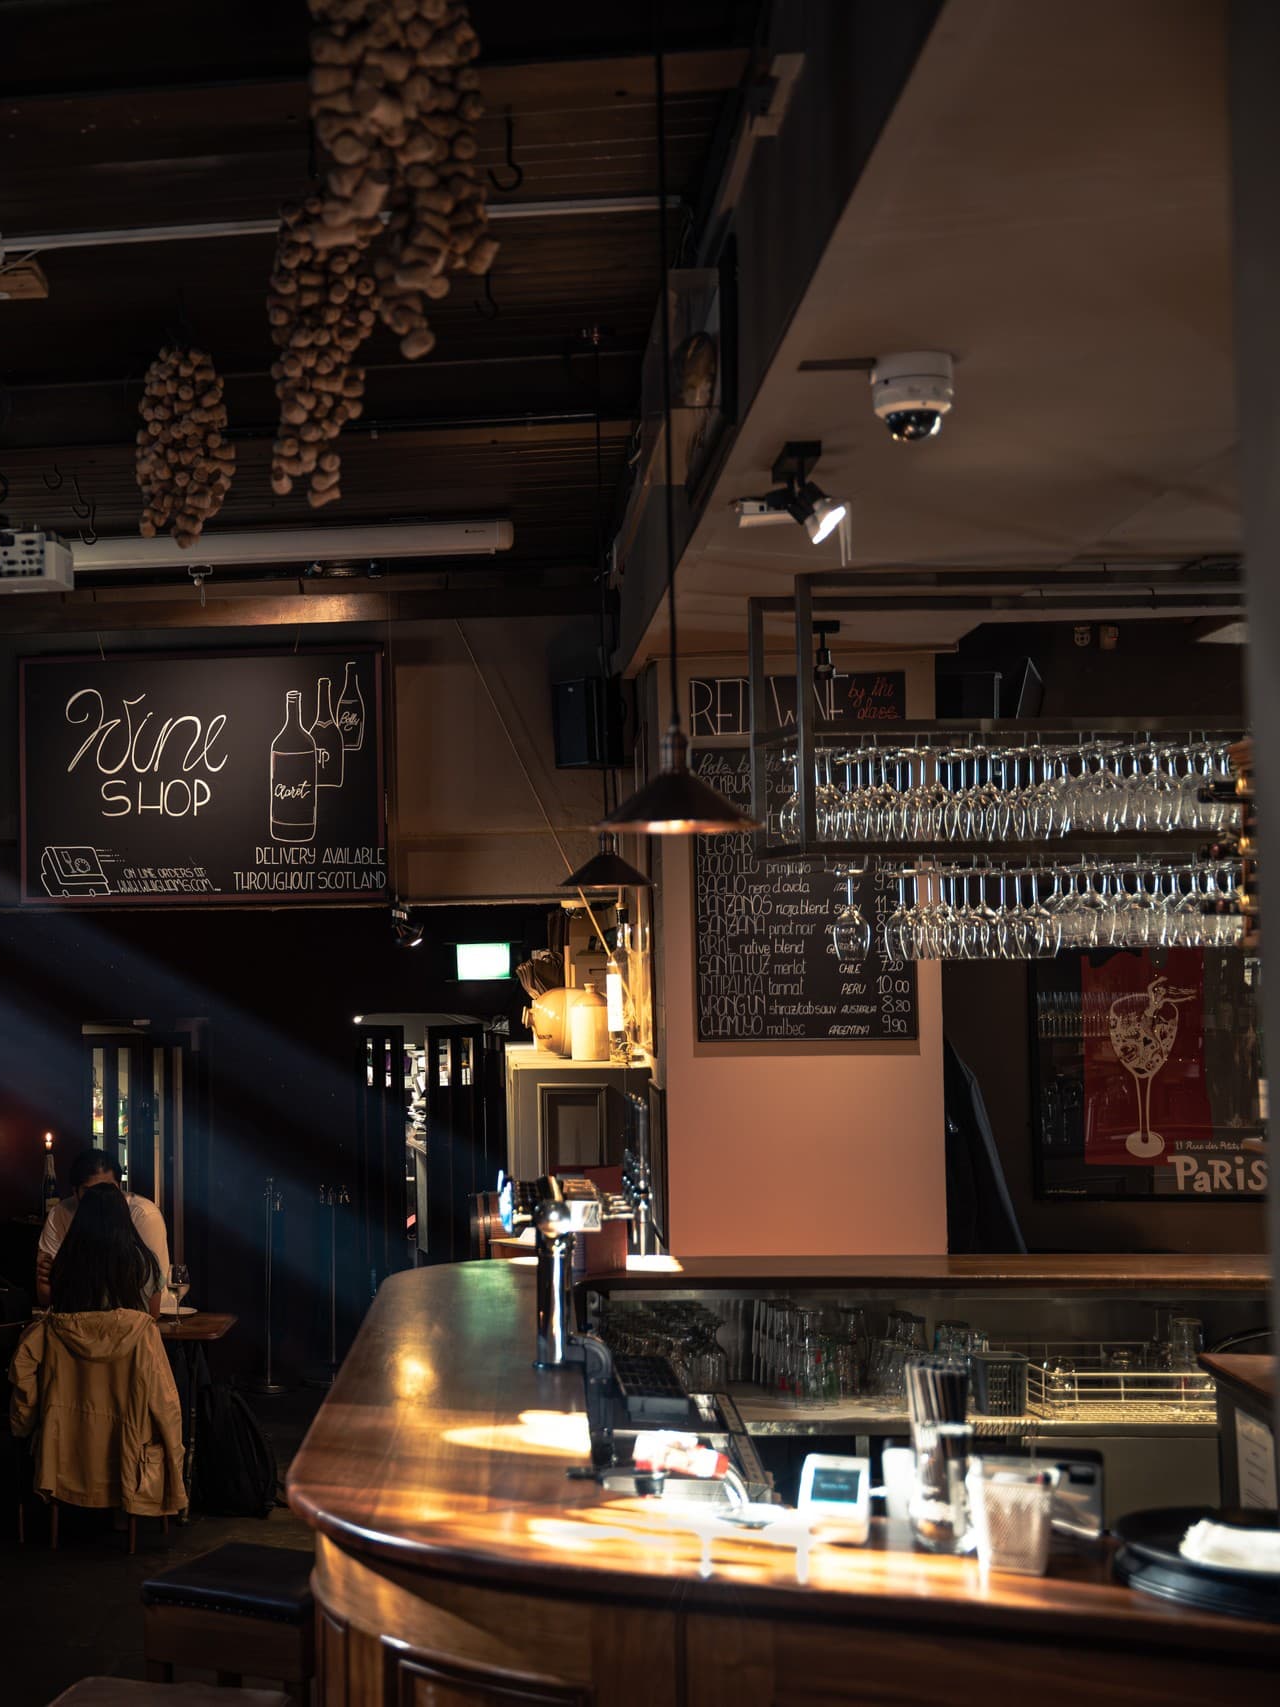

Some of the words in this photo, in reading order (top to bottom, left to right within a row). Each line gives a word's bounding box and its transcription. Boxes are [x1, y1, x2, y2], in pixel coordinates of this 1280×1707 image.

[848, 678, 865, 709] by
[65, 688, 228, 775] Wine
[100, 779, 211, 817] SHOP
[273, 780, 312, 800] Claret
[255, 847, 316, 865] DELIVERY
[322, 847, 386, 865] AVAILABLE
[697, 854, 735, 875] PAOLO
[736, 854, 760, 874] LEO
[157, 868, 194, 879] ORDERS
[233, 870, 315, 891] THROUGHOUT
[317, 870, 386, 890] SCOTLAND
[698, 874, 747, 896] BAGLIO
[748, 884, 771, 895] nero
[698, 894, 773, 917] MANZANOS
[800, 897, 829, 915] blend
[698, 914, 766, 936] SANZANA
[740, 938, 770, 955] native
[774, 938, 805, 955] blend
[699, 954, 744, 976] SANTA
[746, 954, 771, 976] LUZ
[773, 959, 806, 975] merlot
[838, 963, 863, 974] CHILE
[768, 976, 804, 996] tannat
[841, 982, 868, 995] PERU
[875, 975, 910, 994] 10.00
[700, 1015, 763, 1036] CHAMUYO
[766, 1017, 806, 1036] malbec
[827, 1024, 871, 1036] ARGENTINA
